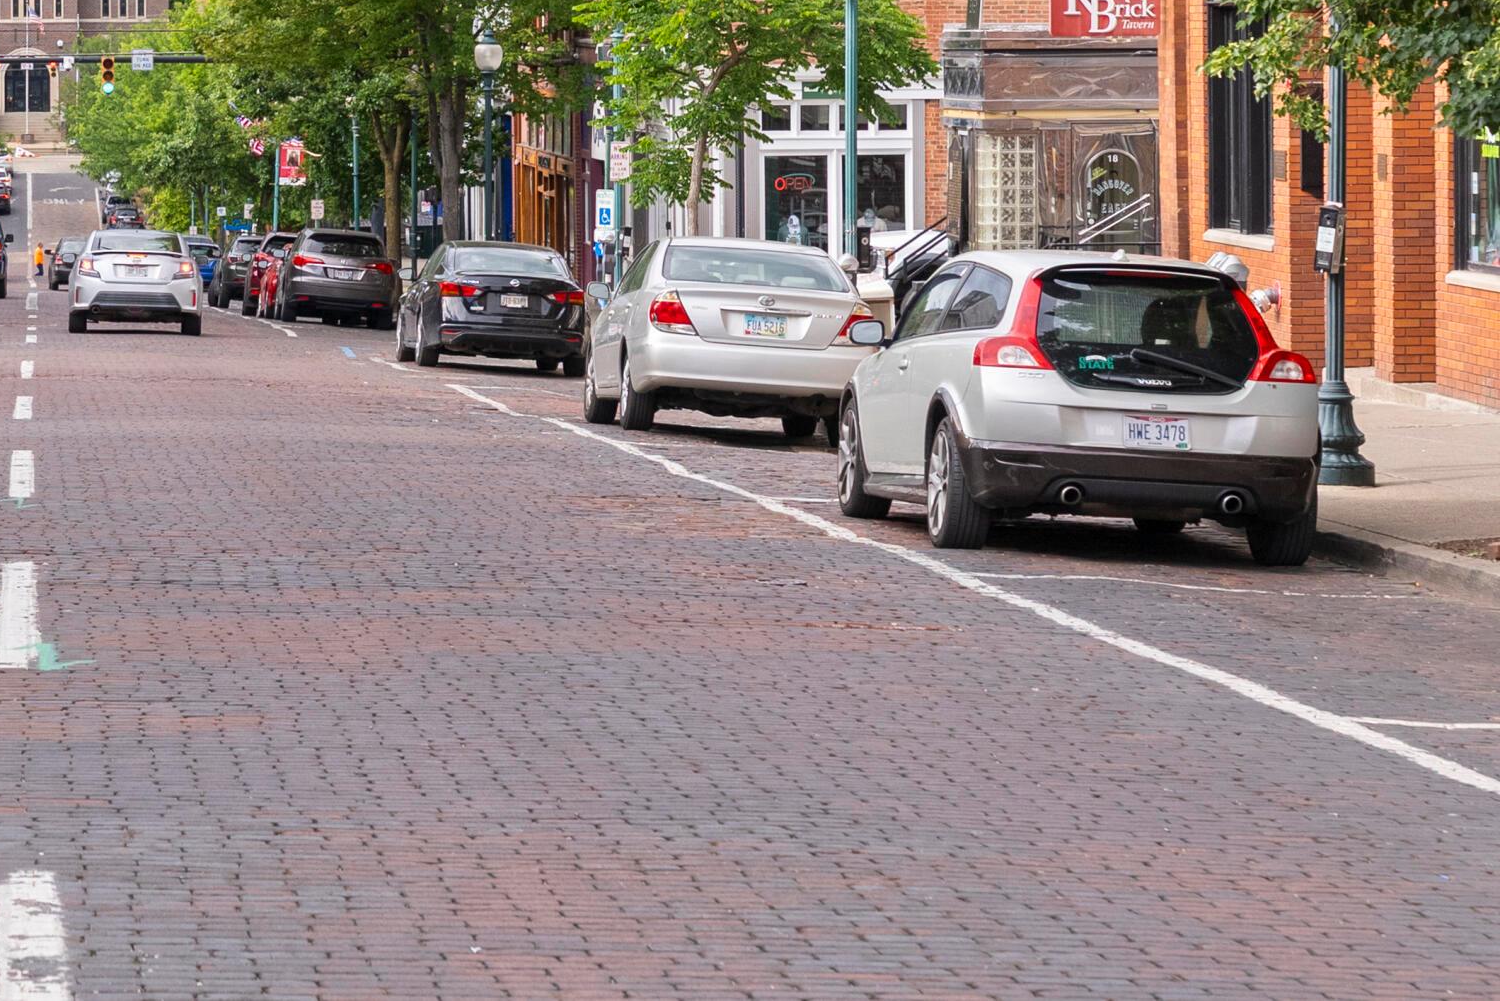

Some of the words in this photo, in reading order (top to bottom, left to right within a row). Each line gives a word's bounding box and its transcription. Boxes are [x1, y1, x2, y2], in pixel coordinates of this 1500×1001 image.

[1122, 19, 1155, 30] Tavern
[1107, 154, 1119, 163] 18
[774, 176, 813, 191] OPEN
[1078, 356, 1115, 370] STATE
[1137, 378, 1173, 388] VOLVO
[1128, 423, 1151, 440] HWE
[1155, 424, 1186, 441] 3478
